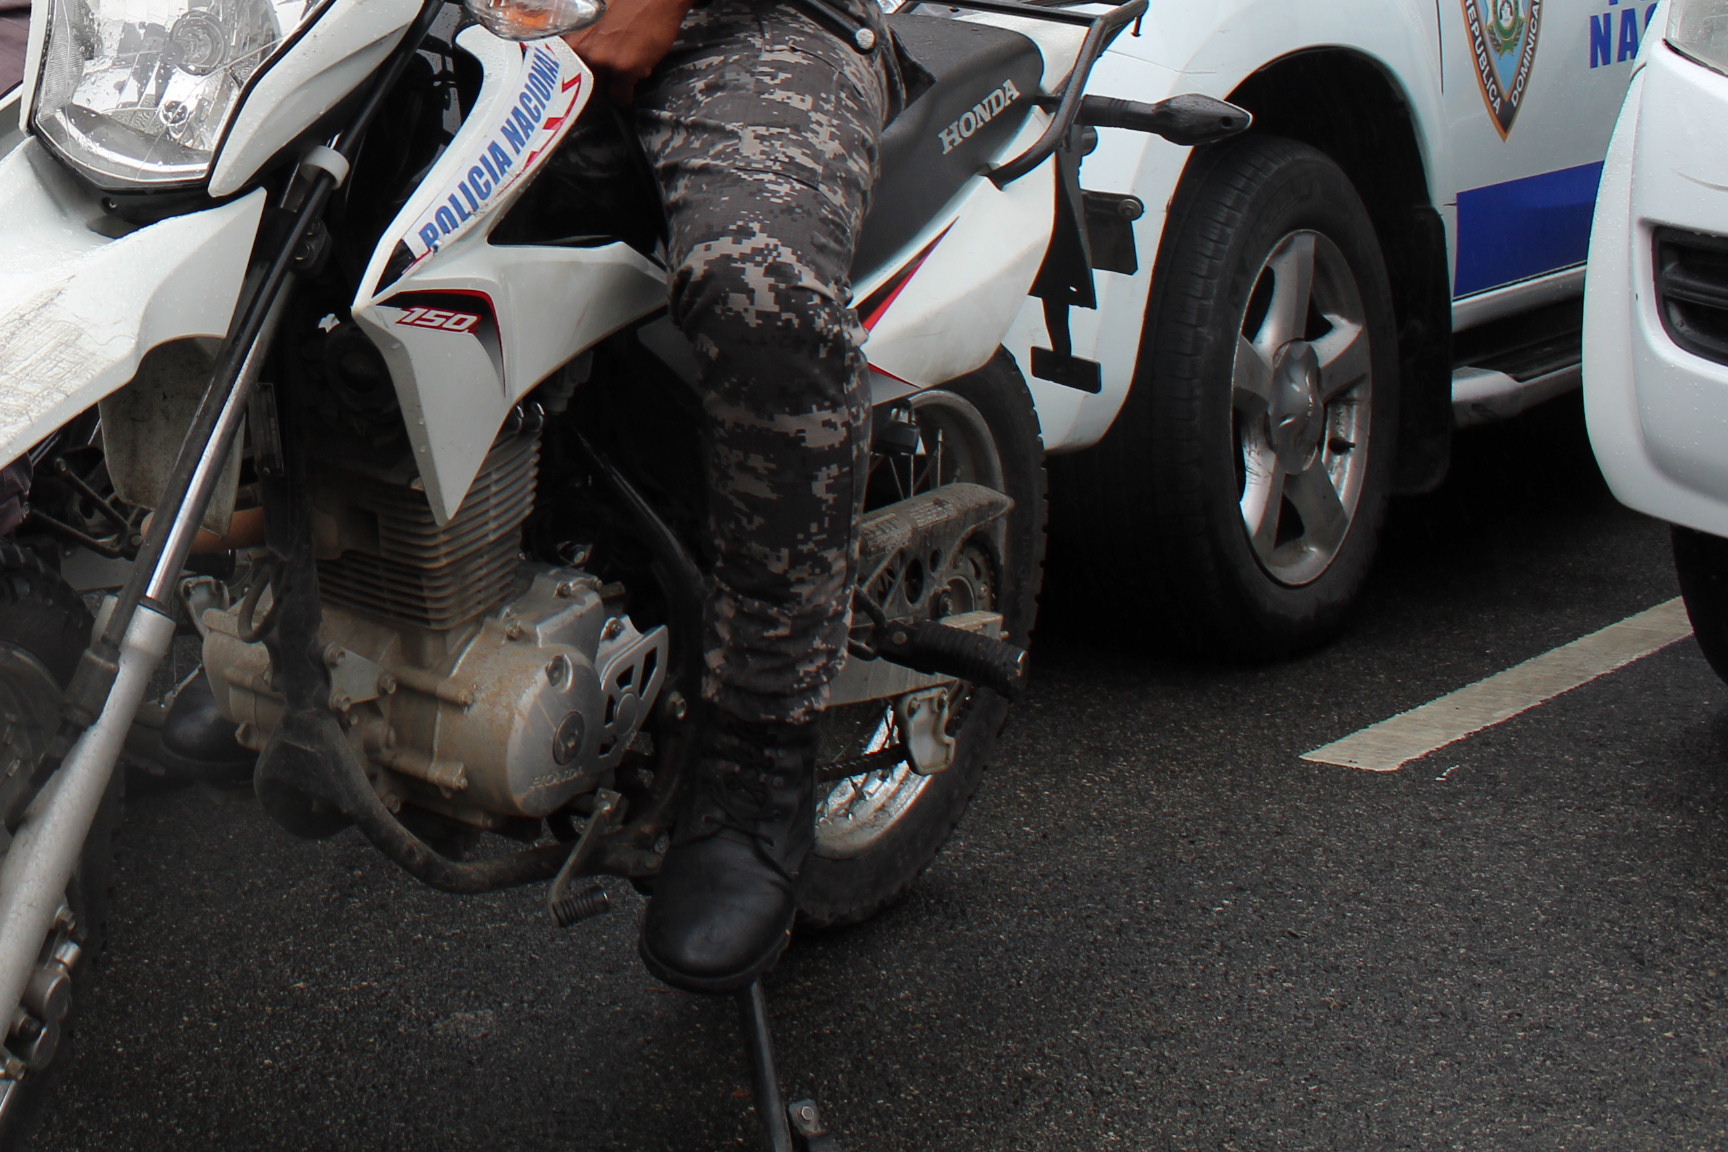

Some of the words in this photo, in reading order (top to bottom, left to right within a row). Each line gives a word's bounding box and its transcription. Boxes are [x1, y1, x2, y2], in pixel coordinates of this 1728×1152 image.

[419, 140, 513, 252] POLICIA
[501, 47, 560, 154] NACIONAL
[937, 78, 1020, 155] HONDA
[396, 305, 481, 333] 150
